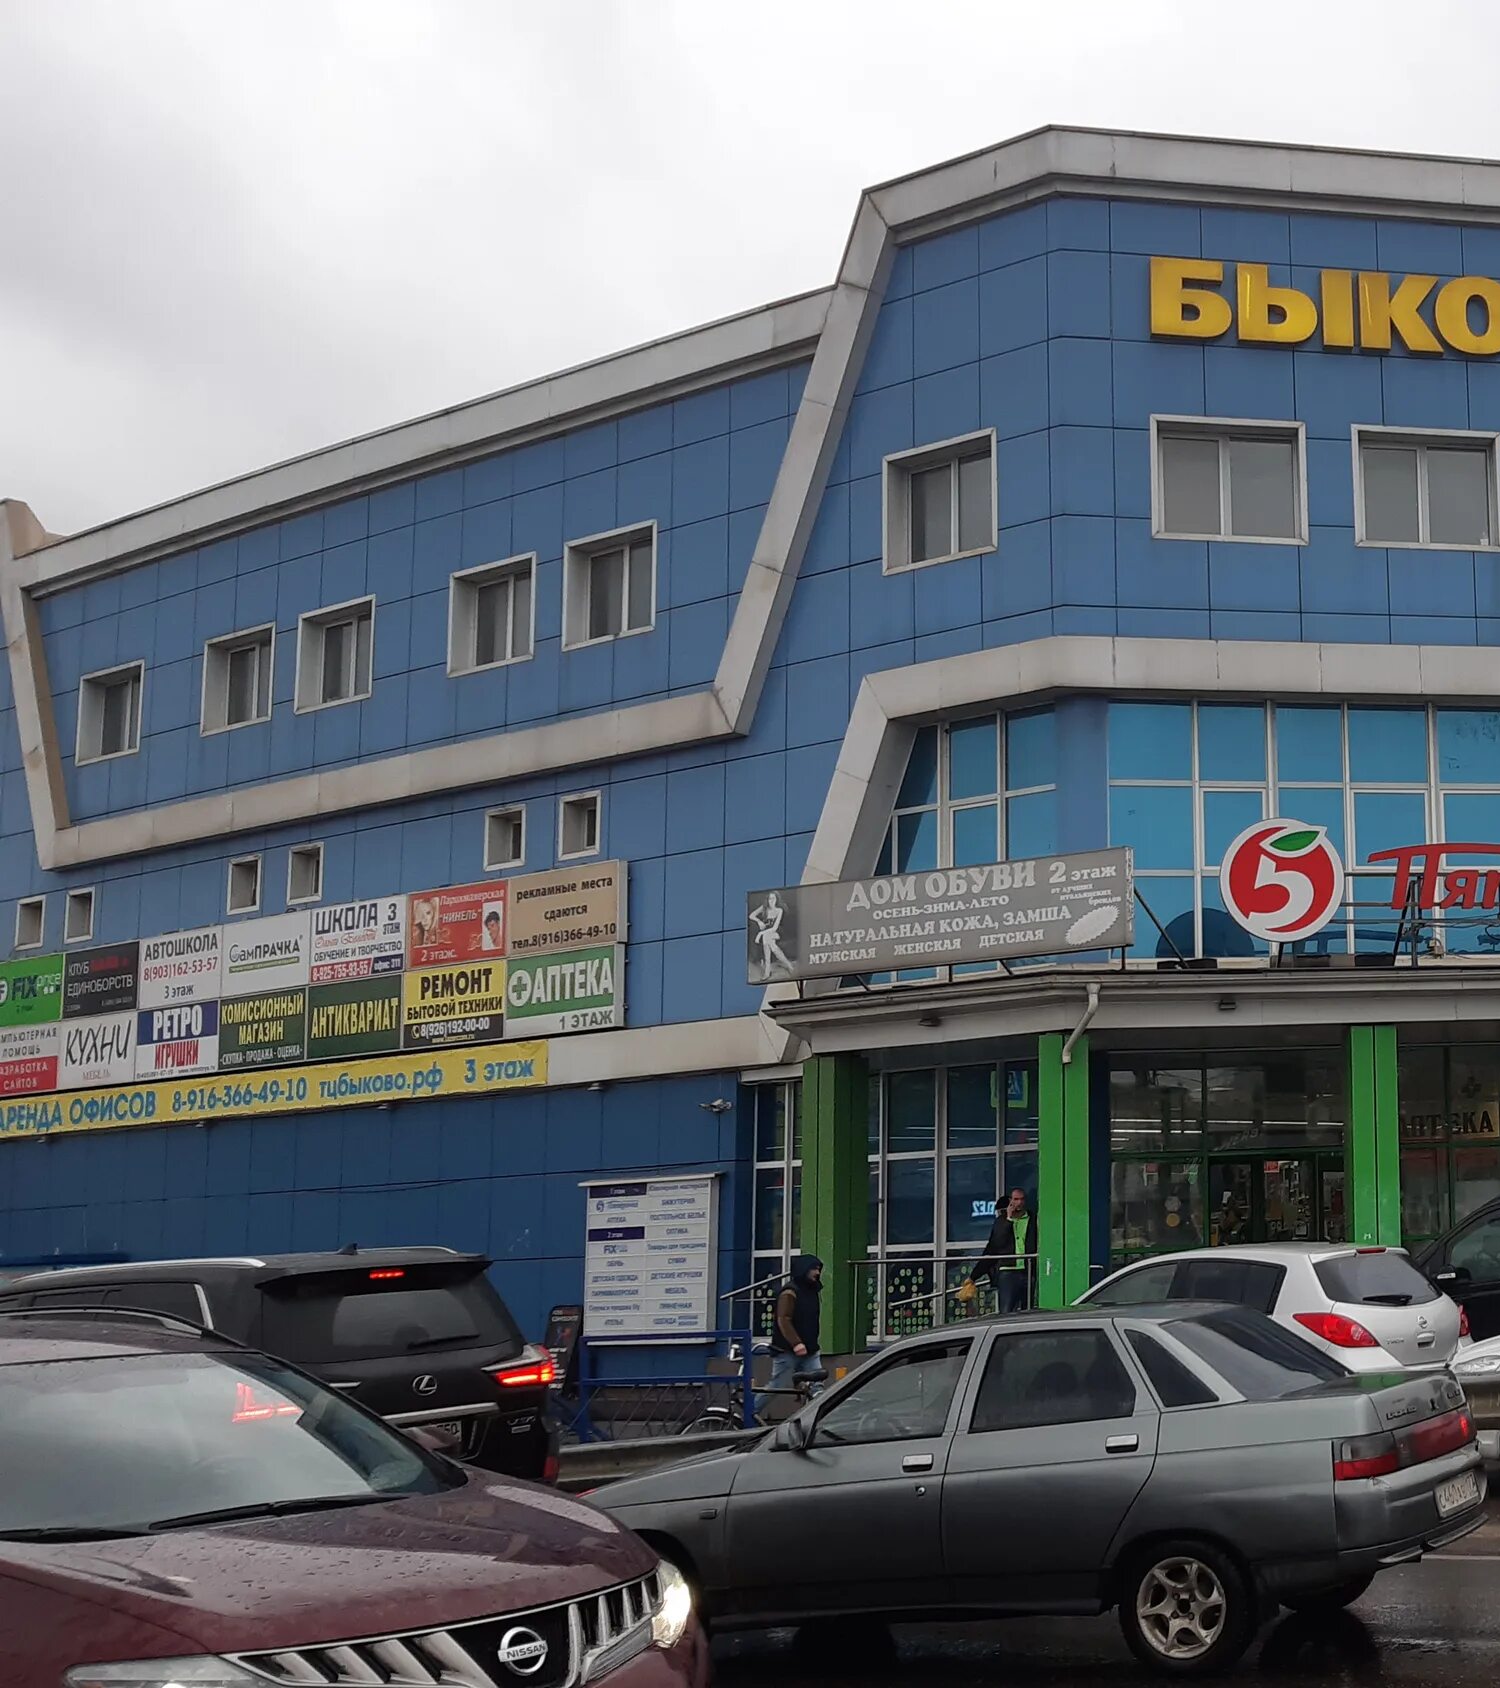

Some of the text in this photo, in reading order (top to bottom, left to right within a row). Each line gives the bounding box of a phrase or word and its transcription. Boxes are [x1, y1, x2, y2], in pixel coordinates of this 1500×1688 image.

[440, 889, 504, 905] Парикмахерская
[516, 876, 612, 903] рекламные места
[846, 860, 1116, 912] ДОМ ОБУВИ 2 этаж
[315, 903, 378, 935] ШКОЛА
[388, 903, 397, 921] 3
[544, 904, 588, 922] сдаются
[810, 905, 1072, 948] НАТУРАЛЬНАЯ КОЖА, ЗАМША
[144, 933, 218, 961] АВТОШКОЛА
[314, 948, 350, 962] ОБУЧЕНИЕ
[357, 941, 403, 956] ТВОРЧЕСТВО
[421, 949, 427, 962] 2
[809, 929, 1045, 965] МУЖСКАЯ ЖЕНСКАЯ ДЕТСКАЯ
[69, 961, 89, 976] КЛУБ
[143, 956, 218, 981] 8(903)162-53-57
[531, 957, 614, 1004] АПТЕКА
[67, 974, 133, 997] ЕДИНОБОРСТВ
[164, 983, 194, 999] 3 этаж
[420, 968, 492, 1000] РЕМОНТ
[221, 992, 304, 1025] КОМИССИОННЫЙ
[311, 998, 399, 1039] АНТИКВАРИАТ
[407, 996, 502, 1020] БЫТОВОЙ ТЕХНИКИ
[571, 1010, 613, 1029] ЭТАЖ
[0, 1027, 57, 1043] МПЬЮТЕРНАЯ
[152, 1004, 203, 1041] РЕТРО
[239, 1020, 284, 1045] МАГАЗИН
[3, 1044, 40, 1058] ПОМОЩЬ
[65, 1020, 131, 1067] КУХНИ
[154, 1039, 199, 1070] ИГРУШКИ
[0, 1061, 48, 1076] АЗРАБОТКА
[4, 1077, 37, 1091] САЙТОВ
[69, 1090, 156, 1125] ОФИСОВ
[172, 1077, 307, 1113] 8-916-366-49-10
[319, 1061, 443, 1100] тцбыково.рф
[465, 1059, 477, 1084] 3
[484, 1059, 534, 1081] этаж
[506, 1644, 546, 1659] NISSAN
